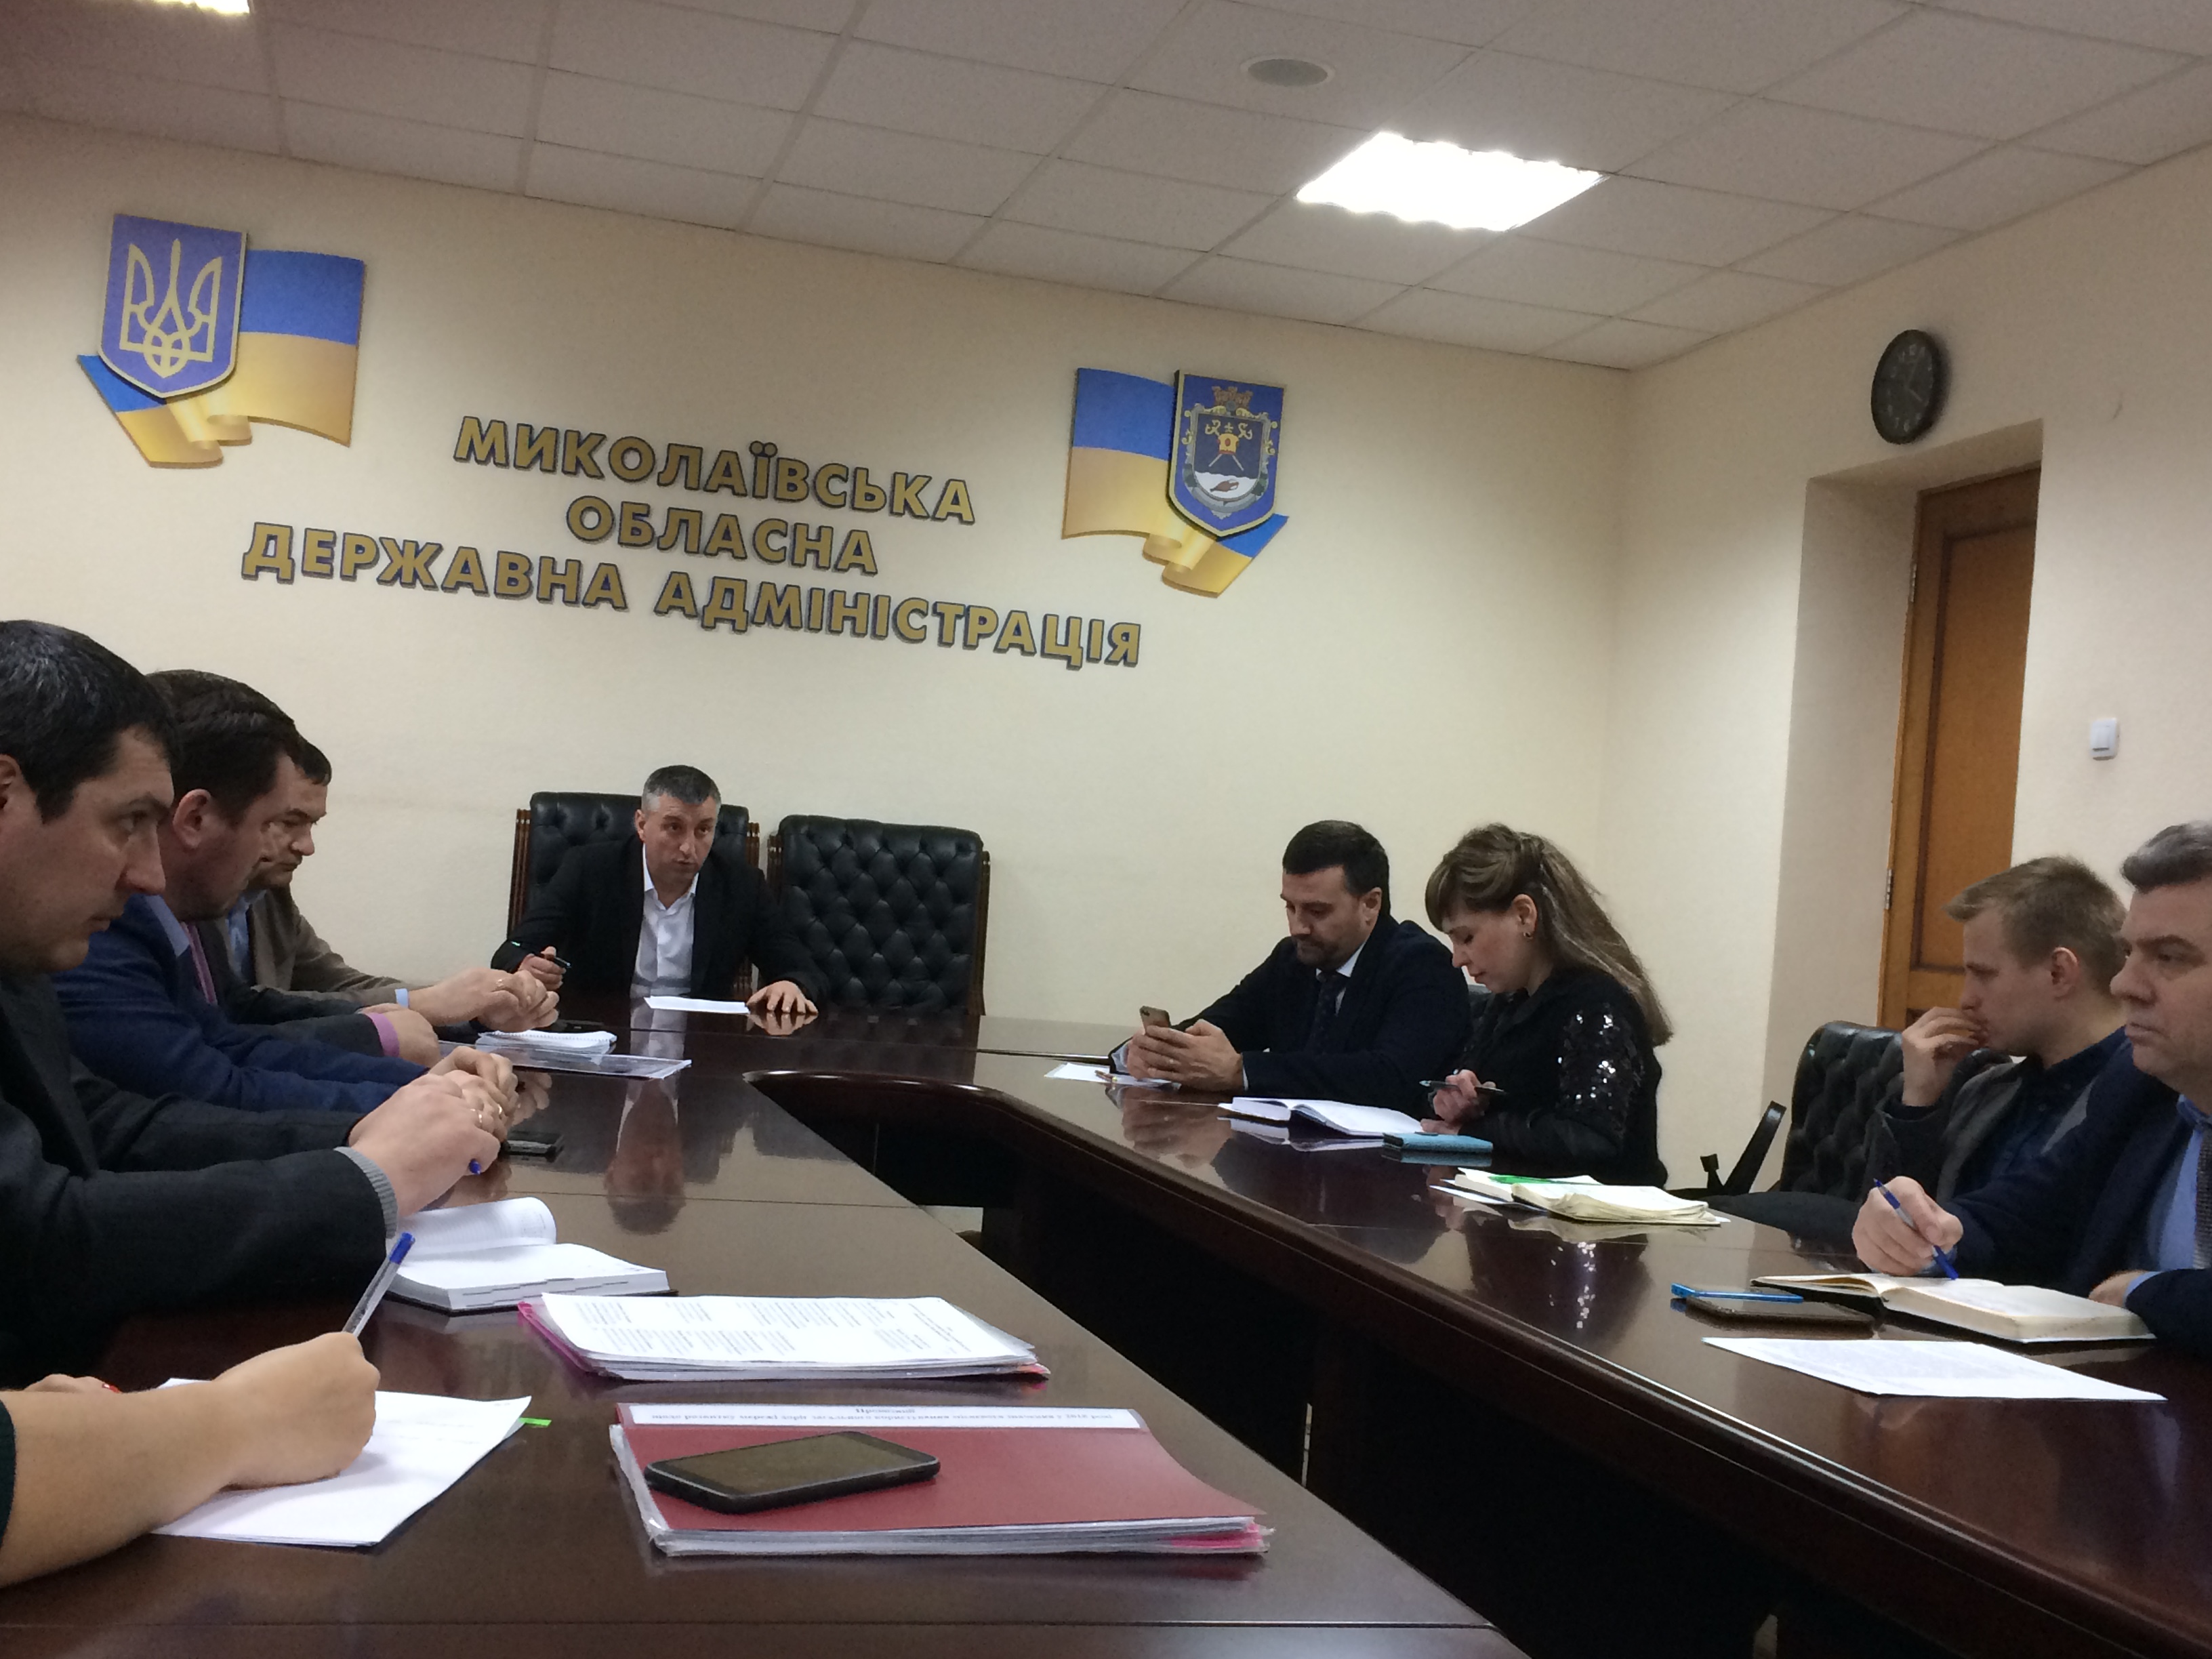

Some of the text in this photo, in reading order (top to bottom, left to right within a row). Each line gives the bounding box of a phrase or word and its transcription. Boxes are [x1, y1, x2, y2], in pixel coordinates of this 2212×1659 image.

[454, 416, 975, 524] МИКОЛАЇВСЬКА
[567, 495, 878, 575] ОБЛАСНА
[241, 522, 1142, 669] ДЕРЖАВНА АДМІНІСТРАЦІЯ
